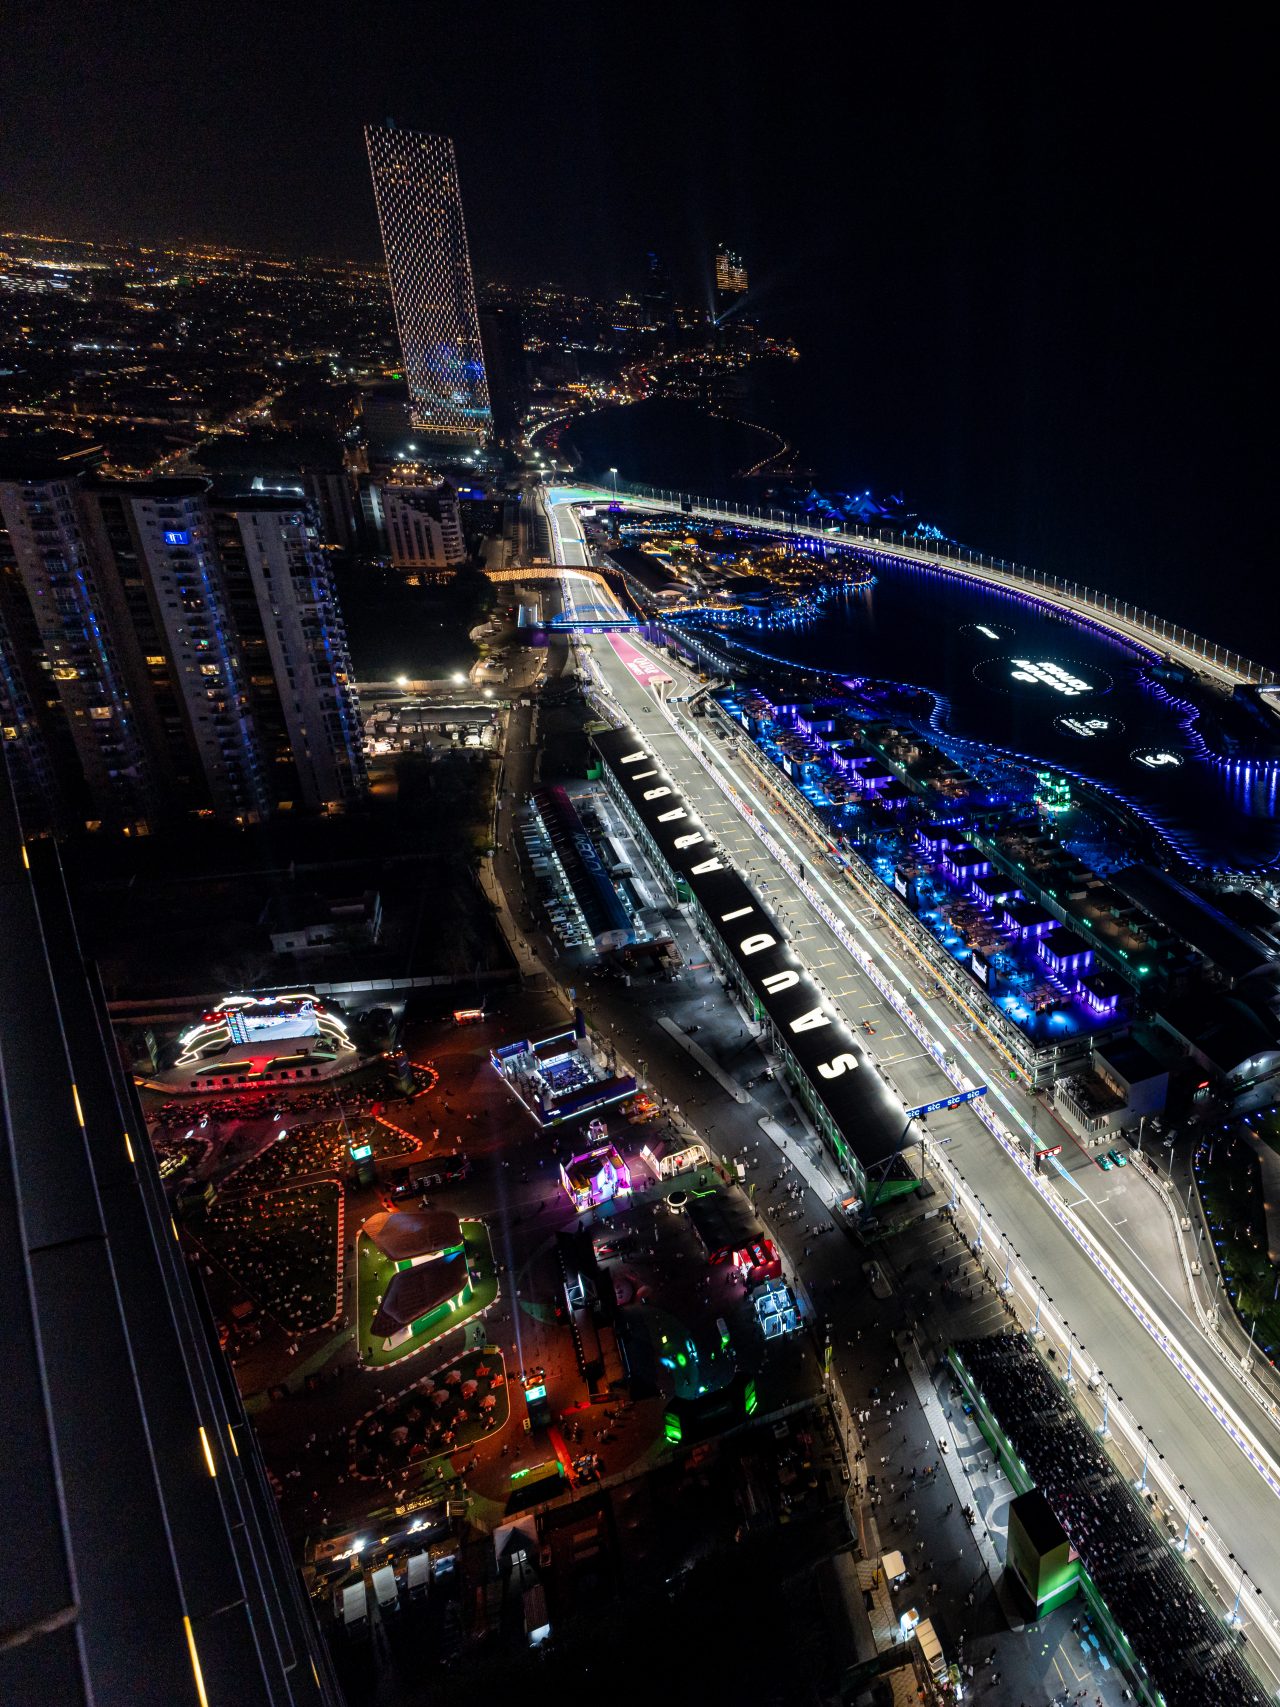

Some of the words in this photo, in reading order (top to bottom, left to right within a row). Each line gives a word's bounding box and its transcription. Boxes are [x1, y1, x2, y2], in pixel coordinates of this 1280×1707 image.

[620, 749, 725, 876] ARABIA
[720, 905, 860, 1081] SAUDI
[966, 1090, 980, 1099] stc
[947, 1096, 961, 1106] stc
[927, 1103, 941, 1112] stc
